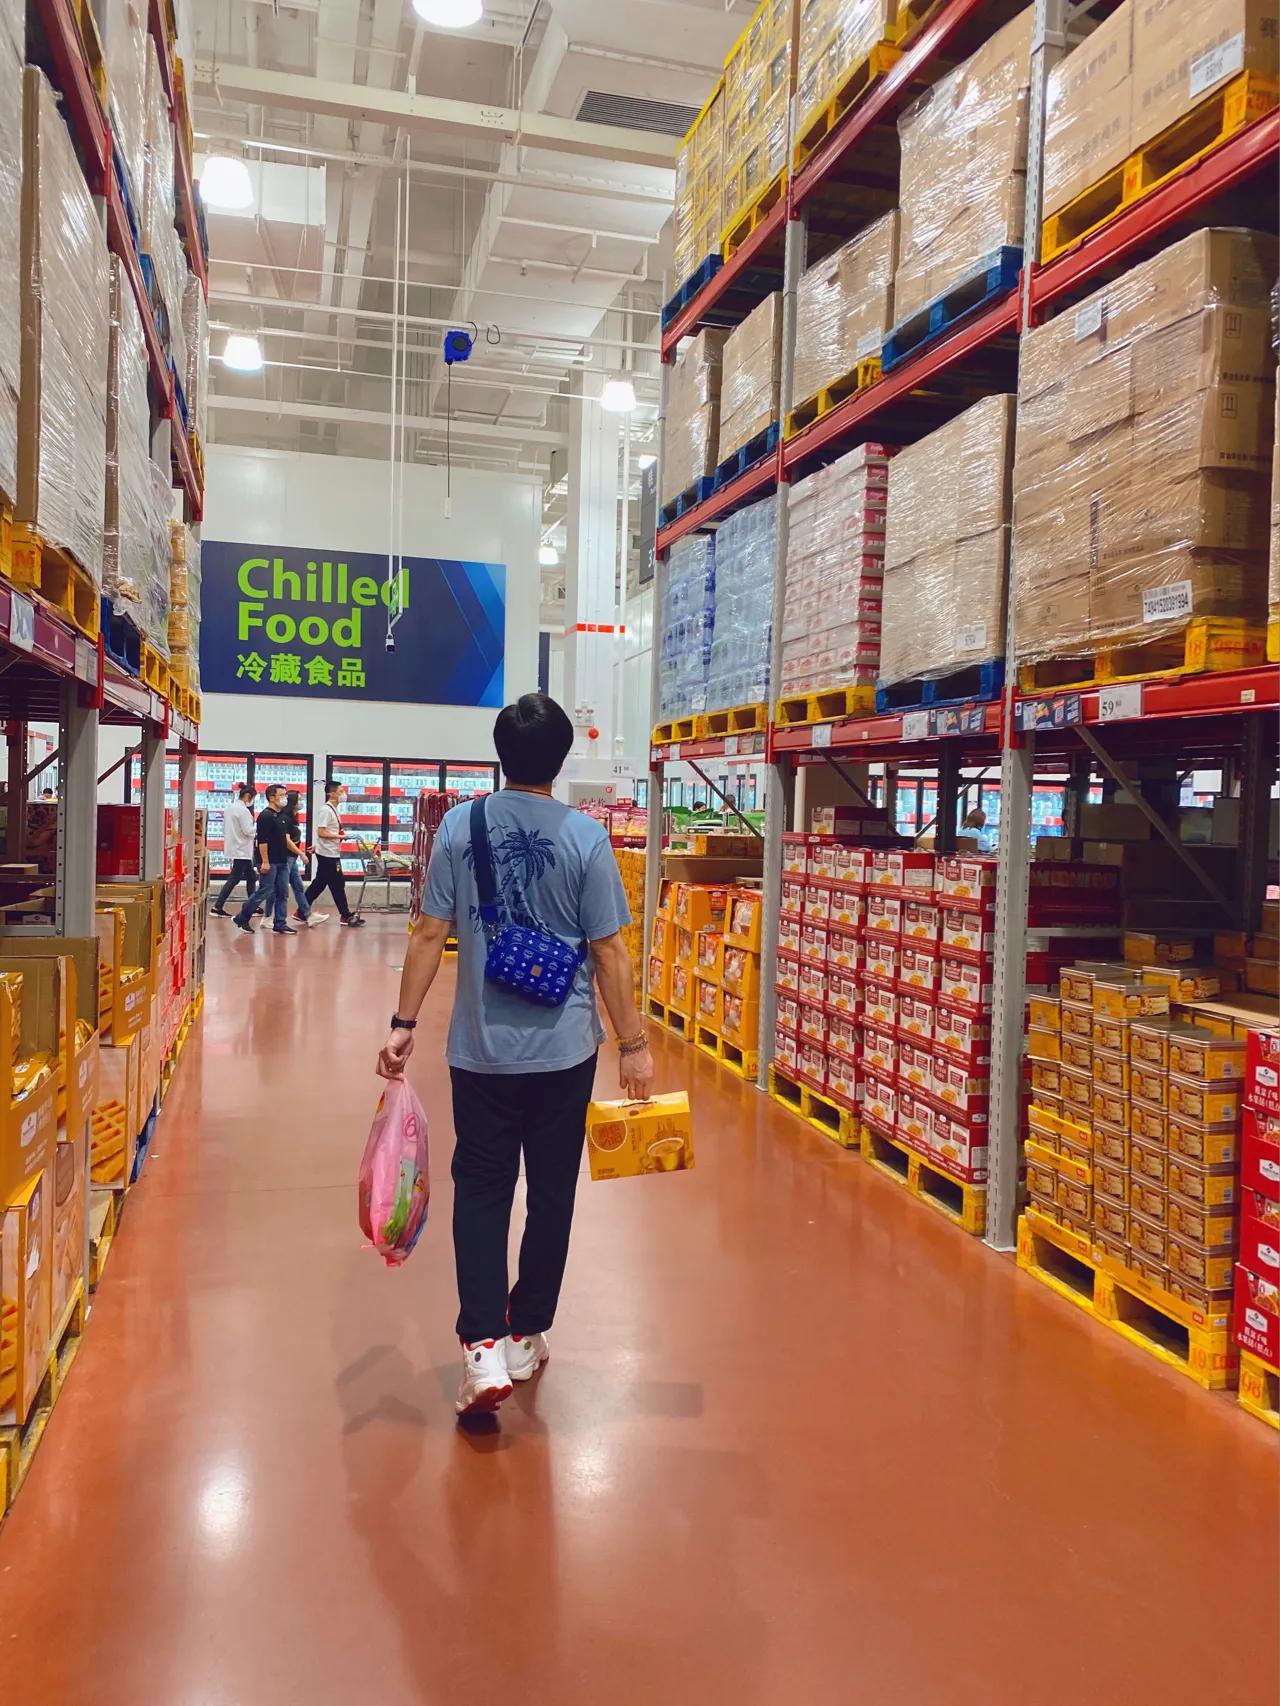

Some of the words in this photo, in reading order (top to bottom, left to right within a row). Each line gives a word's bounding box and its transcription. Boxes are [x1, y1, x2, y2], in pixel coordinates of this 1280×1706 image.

[238, 560, 410, 608] Chilled
[238, 602, 363, 648] Food
[237, 653, 366, 687] 冷藏食品
[1102, 700, 1114, 716] 59
